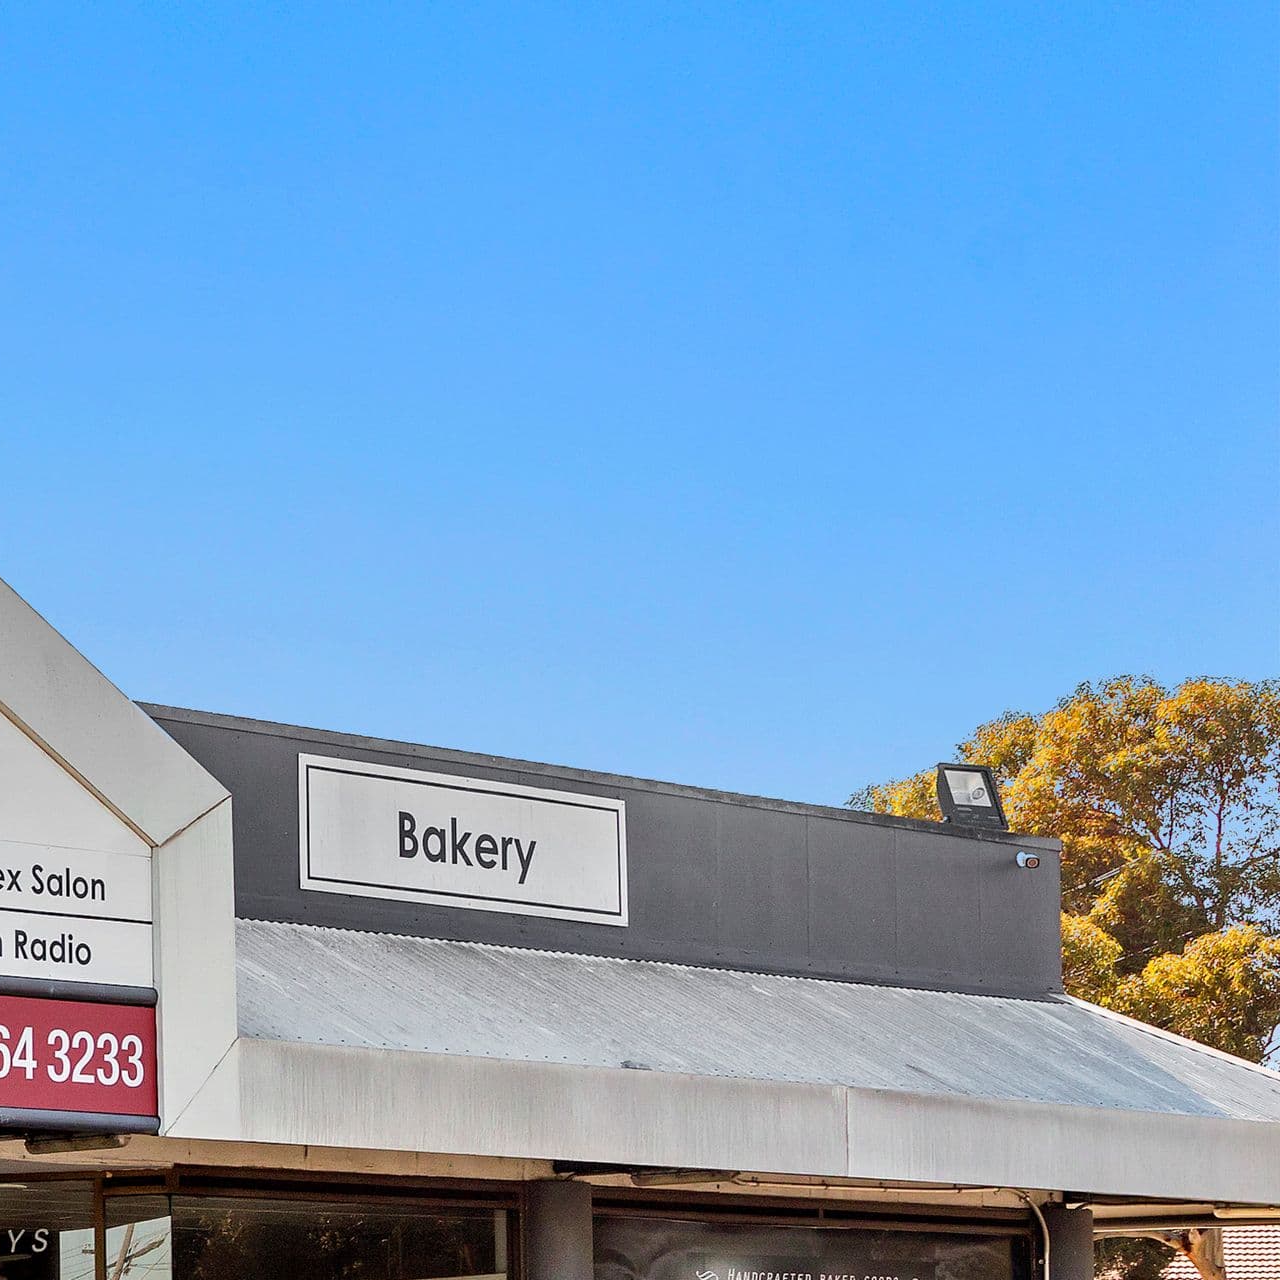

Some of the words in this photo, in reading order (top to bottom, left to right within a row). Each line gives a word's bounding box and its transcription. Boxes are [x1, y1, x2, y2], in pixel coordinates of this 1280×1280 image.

[398, 811, 537, 884] Bakery
[32, 864, 106, 900] Salon
[15, 930, 92, 966] Radio
[47, 1029, 144, 1088] 3233
